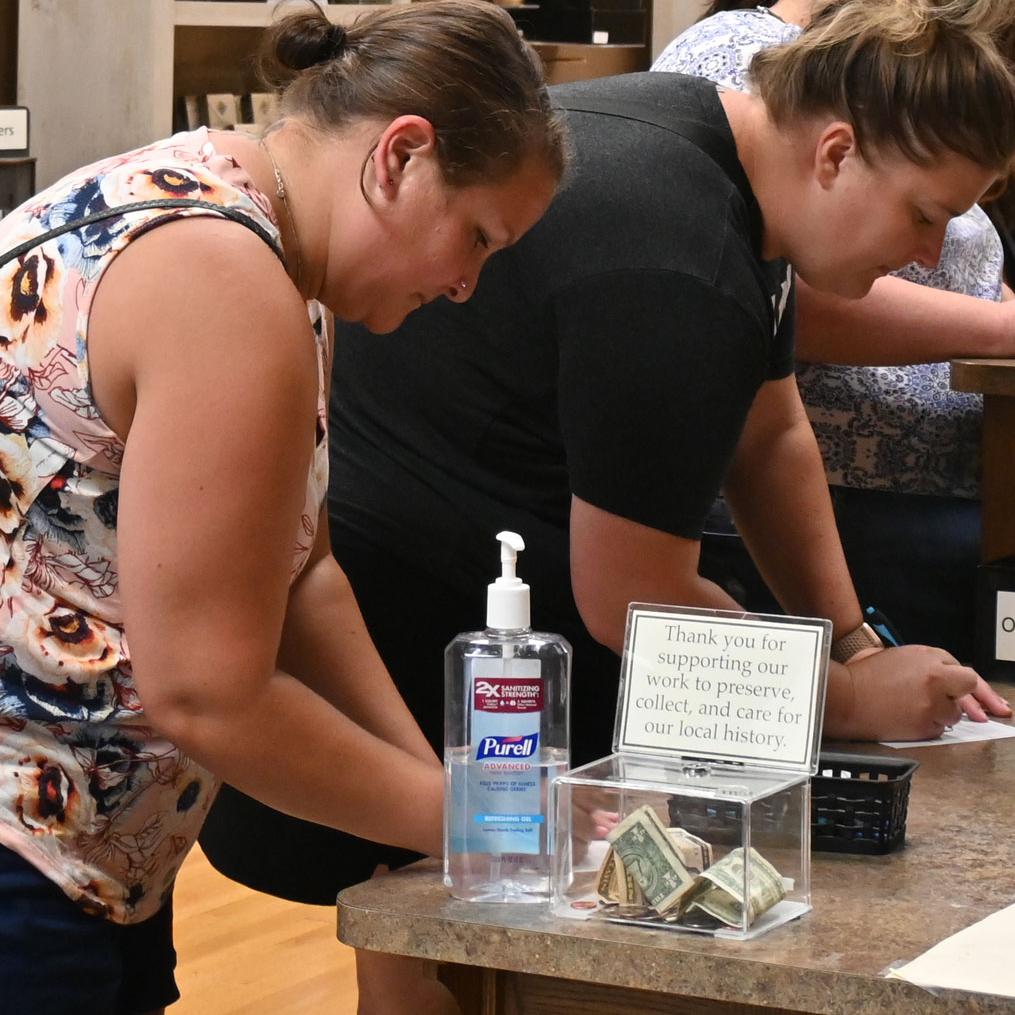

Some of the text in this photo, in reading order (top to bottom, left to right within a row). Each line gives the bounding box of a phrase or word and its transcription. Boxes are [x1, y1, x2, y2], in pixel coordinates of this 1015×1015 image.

[664, 624, 787, 652] Thank you for
[657, 651, 789, 678] supporting our
[646, 673, 795, 703] work to preserve,
[635, 694, 803, 725] collect, and care for
[483, 737, 533, 756] Purell
[644, 720, 787, 752] our local history.
[484, 763, 531, 771] ADVANCED
